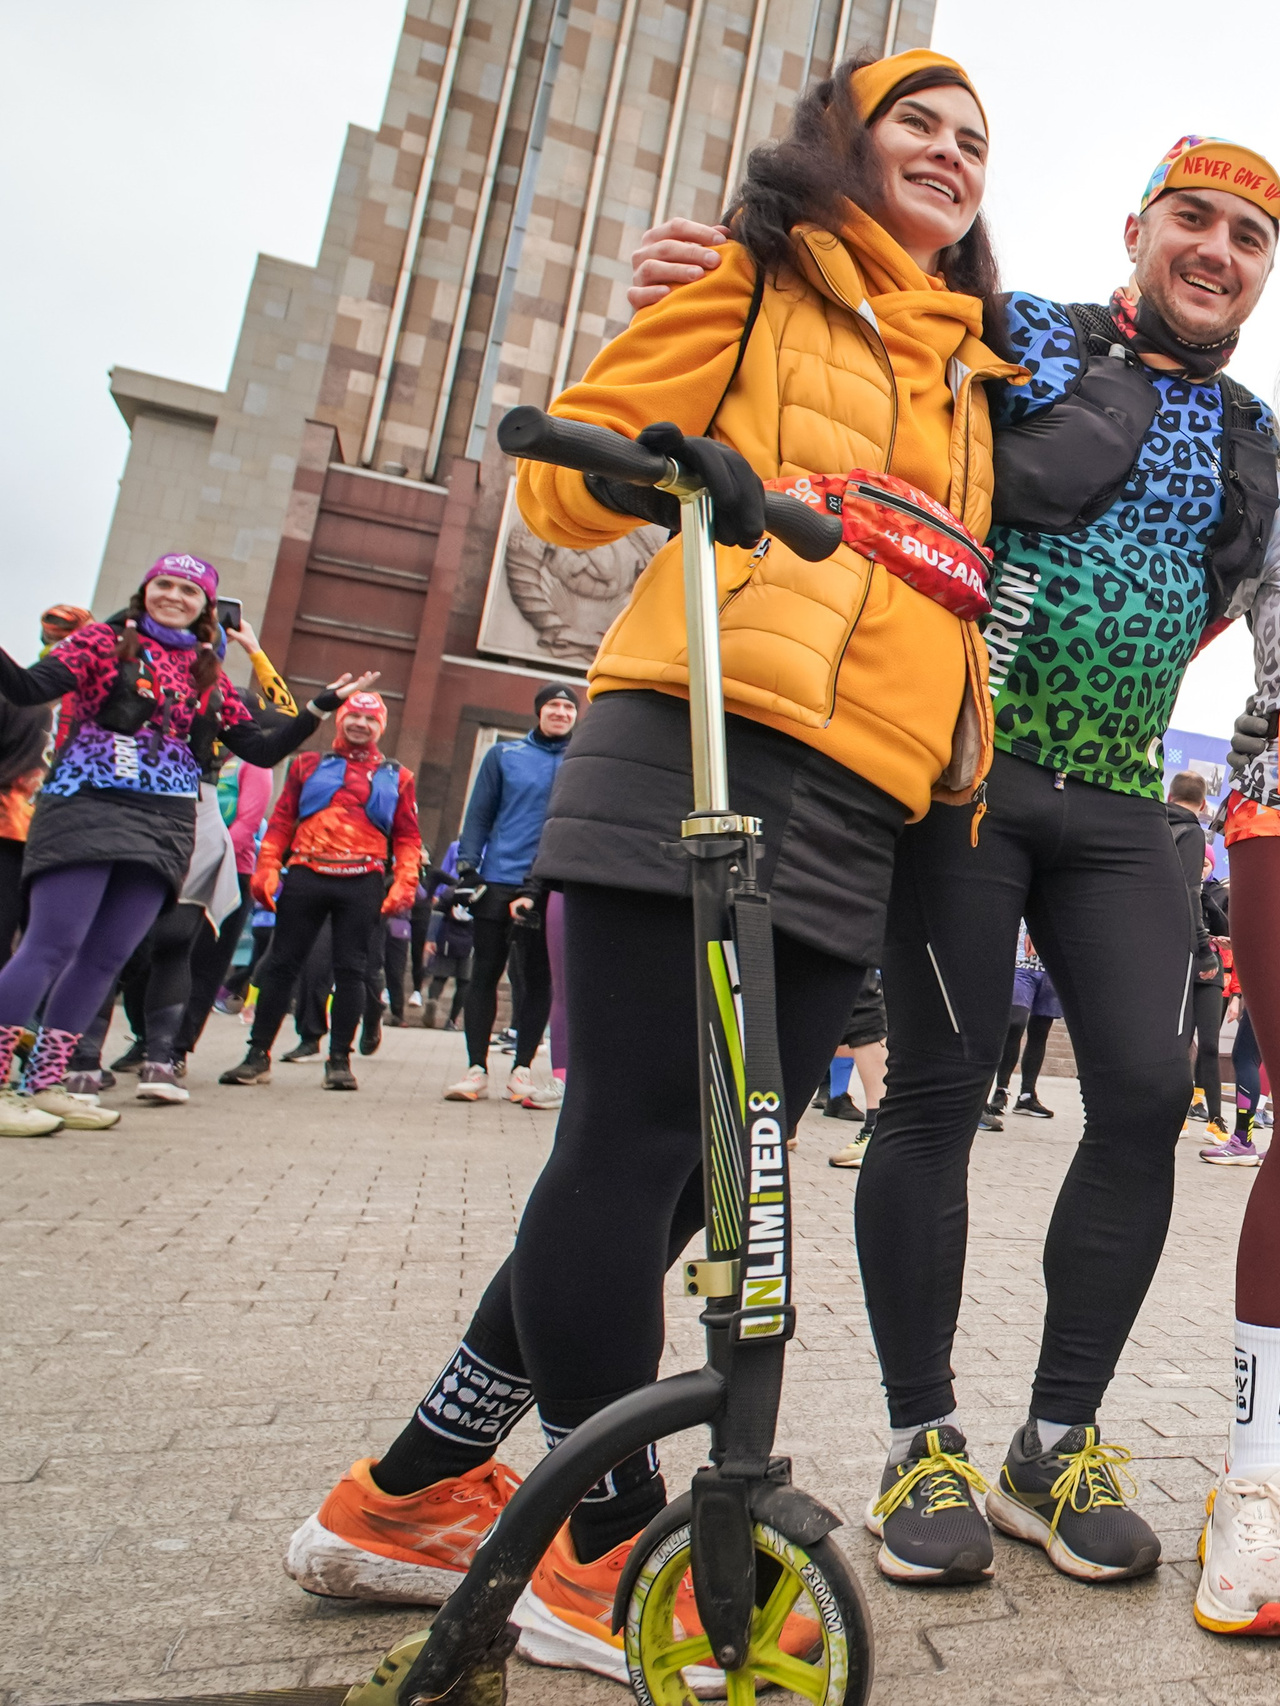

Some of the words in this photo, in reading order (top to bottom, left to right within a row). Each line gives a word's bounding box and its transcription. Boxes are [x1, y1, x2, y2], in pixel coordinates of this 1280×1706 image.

[1183, 156, 1232, 180] NEVER
[1233, 167, 1268, 190] GIVE
[799, 1561, 844, 1634] 230MM
